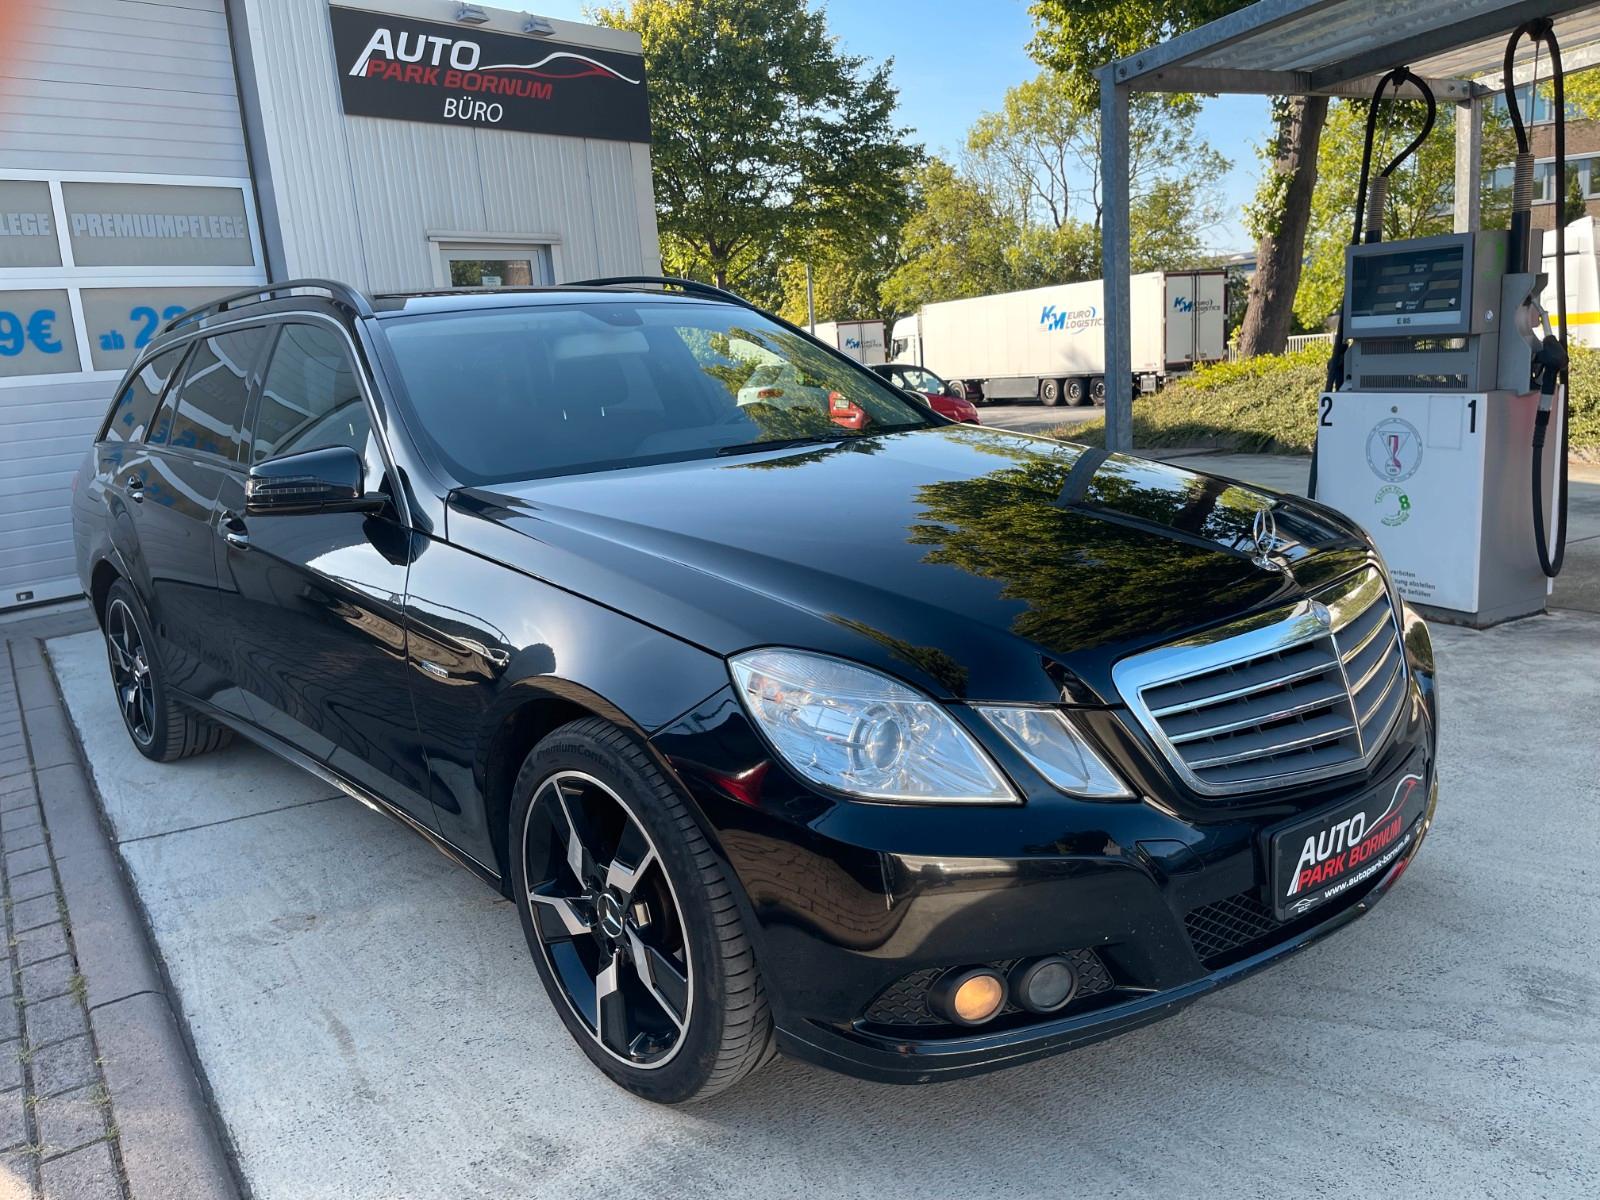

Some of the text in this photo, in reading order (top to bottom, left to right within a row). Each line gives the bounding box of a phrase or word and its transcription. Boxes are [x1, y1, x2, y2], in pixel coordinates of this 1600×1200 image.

[349, 28, 481, 76] AUTO
[367, 58, 553, 100] PARK BORNUM
[443, 96, 503, 123] BÜRO
[71, 213, 245, 238] PREMIUMPFLEGE
[1040, 305, 1091, 331] KM EURO
[1173, 297, 1193, 312] KM
[100, 330, 126, 351] ab
[1320, 396, 1333, 426] 2
[1467, 400, 1477, 433] 1
[1287, 812, 1366, 896] AUTO
[1298, 816, 1402, 893] PARK BORNUM
[1324, 833, 1411, 898] www.autopark-bornum.de
